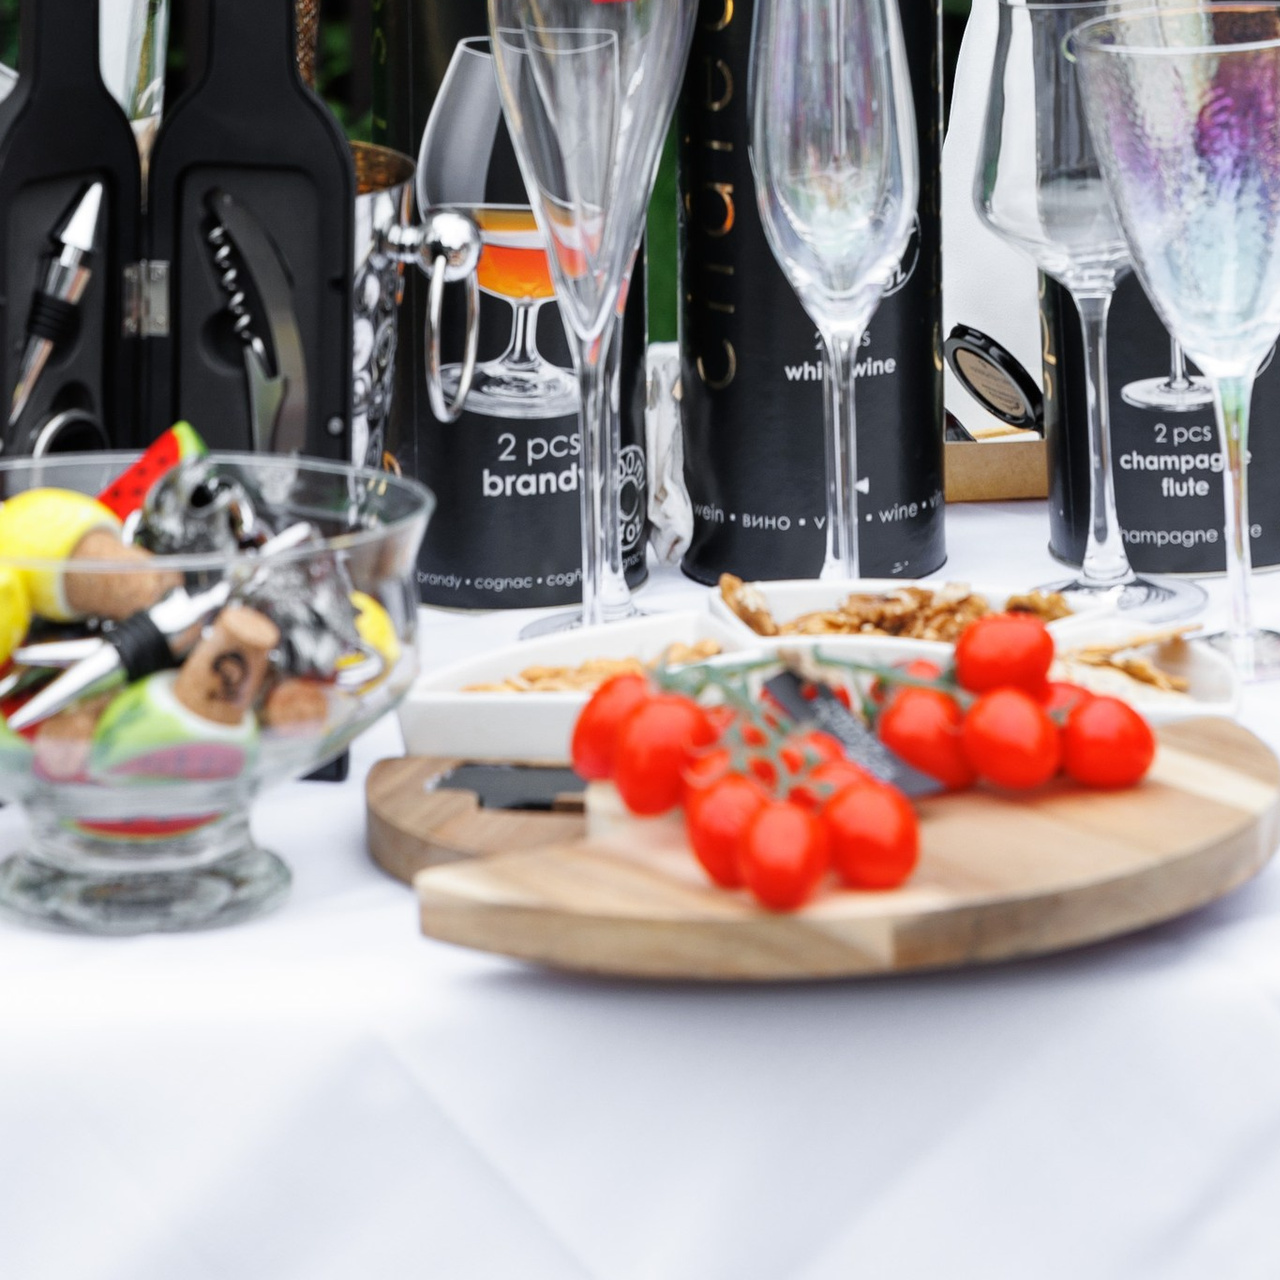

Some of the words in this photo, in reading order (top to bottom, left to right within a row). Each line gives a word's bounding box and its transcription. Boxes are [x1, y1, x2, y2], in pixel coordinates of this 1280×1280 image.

[784, 360, 823, 381] whi
[853, 357, 896, 378] wine
[1154, 423, 1168, 443] 2
[1173, 423, 1212, 447] pcs
[498, 433, 516, 461] 2
[527, 434, 581, 466] pcs
[1120, 450, 1251, 474] champag
[1161, 477, 1210, 497] flute
[878, 502, 918, 523] wine
[1120, 525, 1218, 547] hampagne
[417, 569, 461, 590] brandy
[475, 575, 533, 592] cognac
